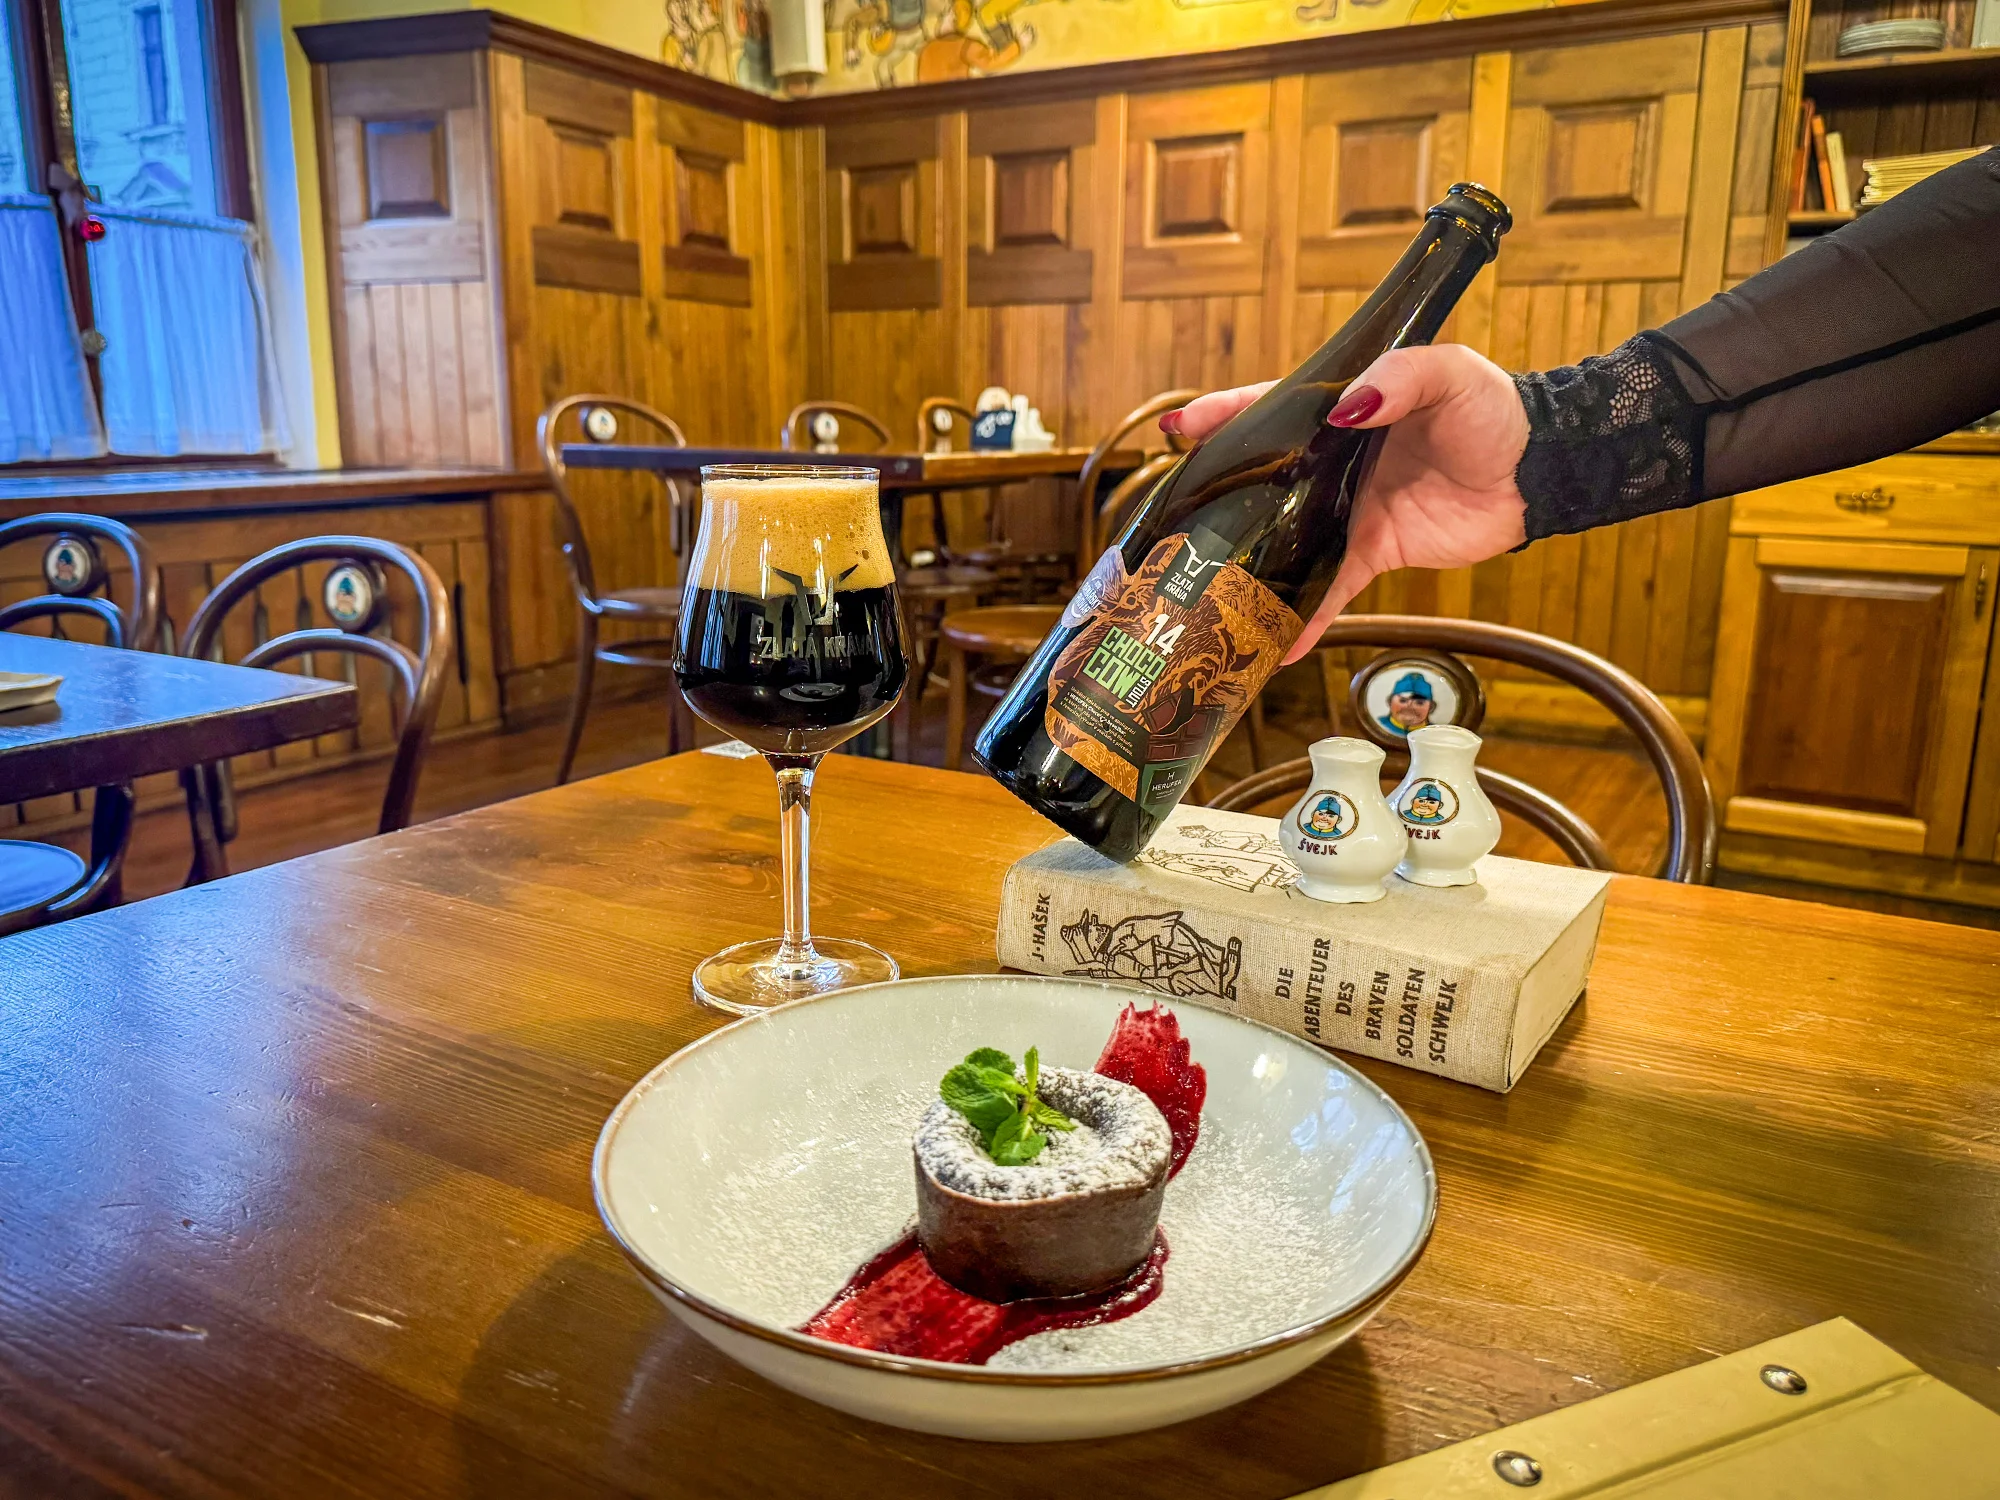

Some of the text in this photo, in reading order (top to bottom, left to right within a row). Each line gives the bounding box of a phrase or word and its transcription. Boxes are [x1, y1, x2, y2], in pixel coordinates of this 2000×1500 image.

[1164, 582, 1188, 602] KRÁVA
[1171, 572, 1195, 592] ZLATÁ
[1101, 626, 1167, 681] CHOCO
[1144, 613, 1186, 656] 14
[1083, 646, 1141, 700] COW
[1125, 676, 1152, 708] STOUT
[1297, 837, 1338, 856] ŠVEJK
[1275, 967, 1294, 1000] DIE
[1304, 937, 1331, 1039] ABENTEUER
[1335, 981, 1355, 1016] DES
[1365, 970, 1390, 1040] BRAVEN
[1396, 967, 1426, 1059] SOLDATEN
[1428, 978, 1458, 1063] SCHWEJK
